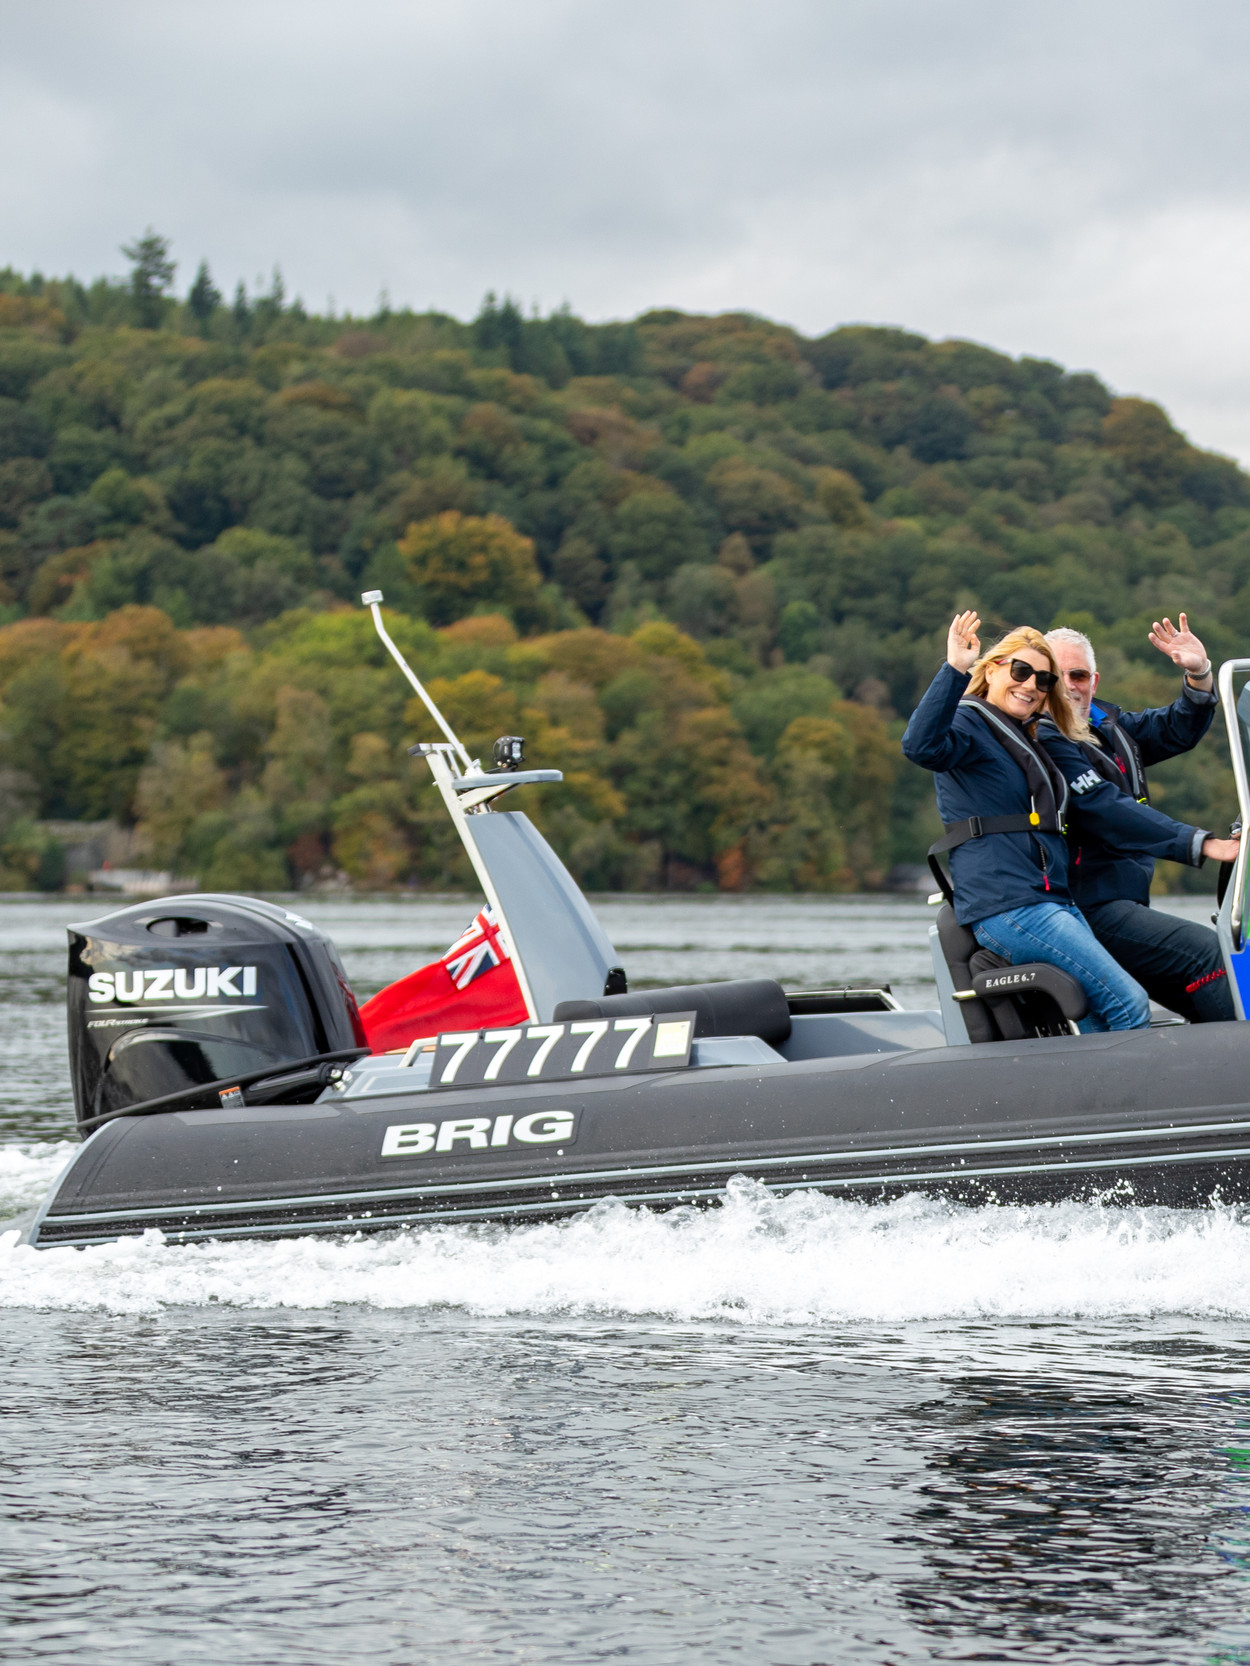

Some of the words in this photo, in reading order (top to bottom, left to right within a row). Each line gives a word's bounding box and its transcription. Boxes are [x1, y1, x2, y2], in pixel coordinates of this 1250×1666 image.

[1070, 769, 1102, 795] HH
[88, 966, 257, 1003] SUZUKI
[985, 974, 1020, 988] EAGLE
[1021, 972, 1036, 982] 6.7
[440, 1017, 653, 1083] 77777
[380, 1110, 575, 1157] BRIG
